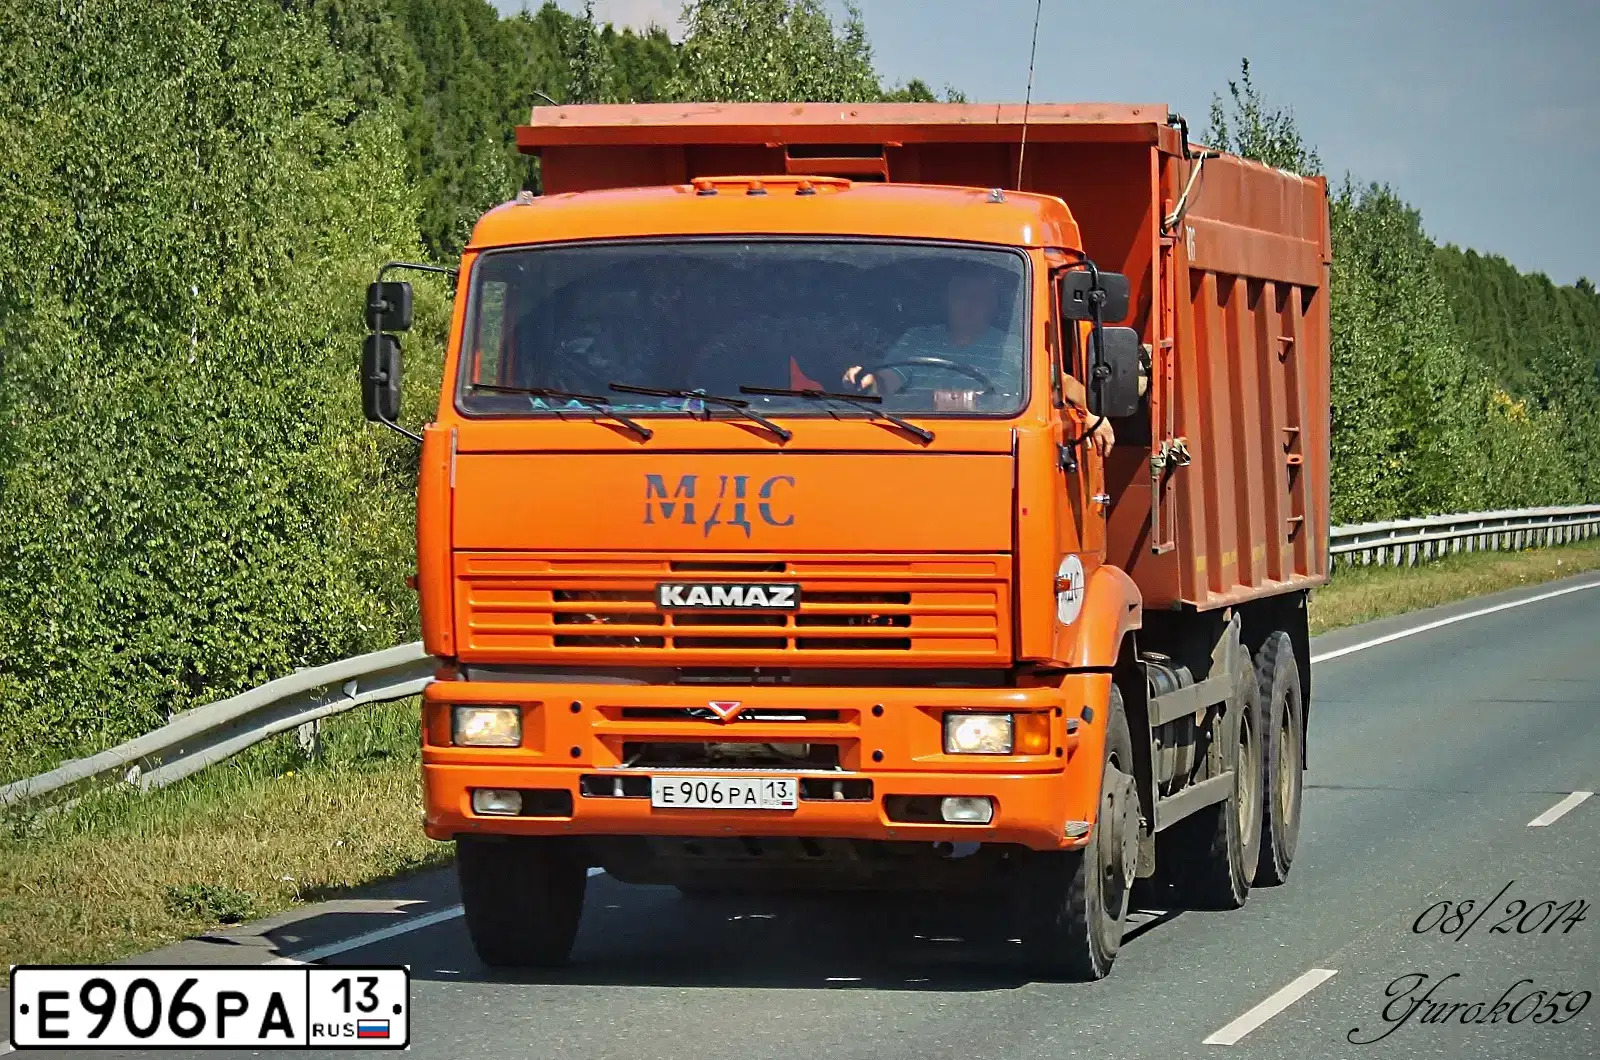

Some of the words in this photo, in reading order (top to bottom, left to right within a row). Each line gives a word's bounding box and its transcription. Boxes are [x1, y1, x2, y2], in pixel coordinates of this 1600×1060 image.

[643, 474, 795, 539] МДС
[660, 586, 795, 607] KAMAZ
[766, 781, 787, 799] 13
